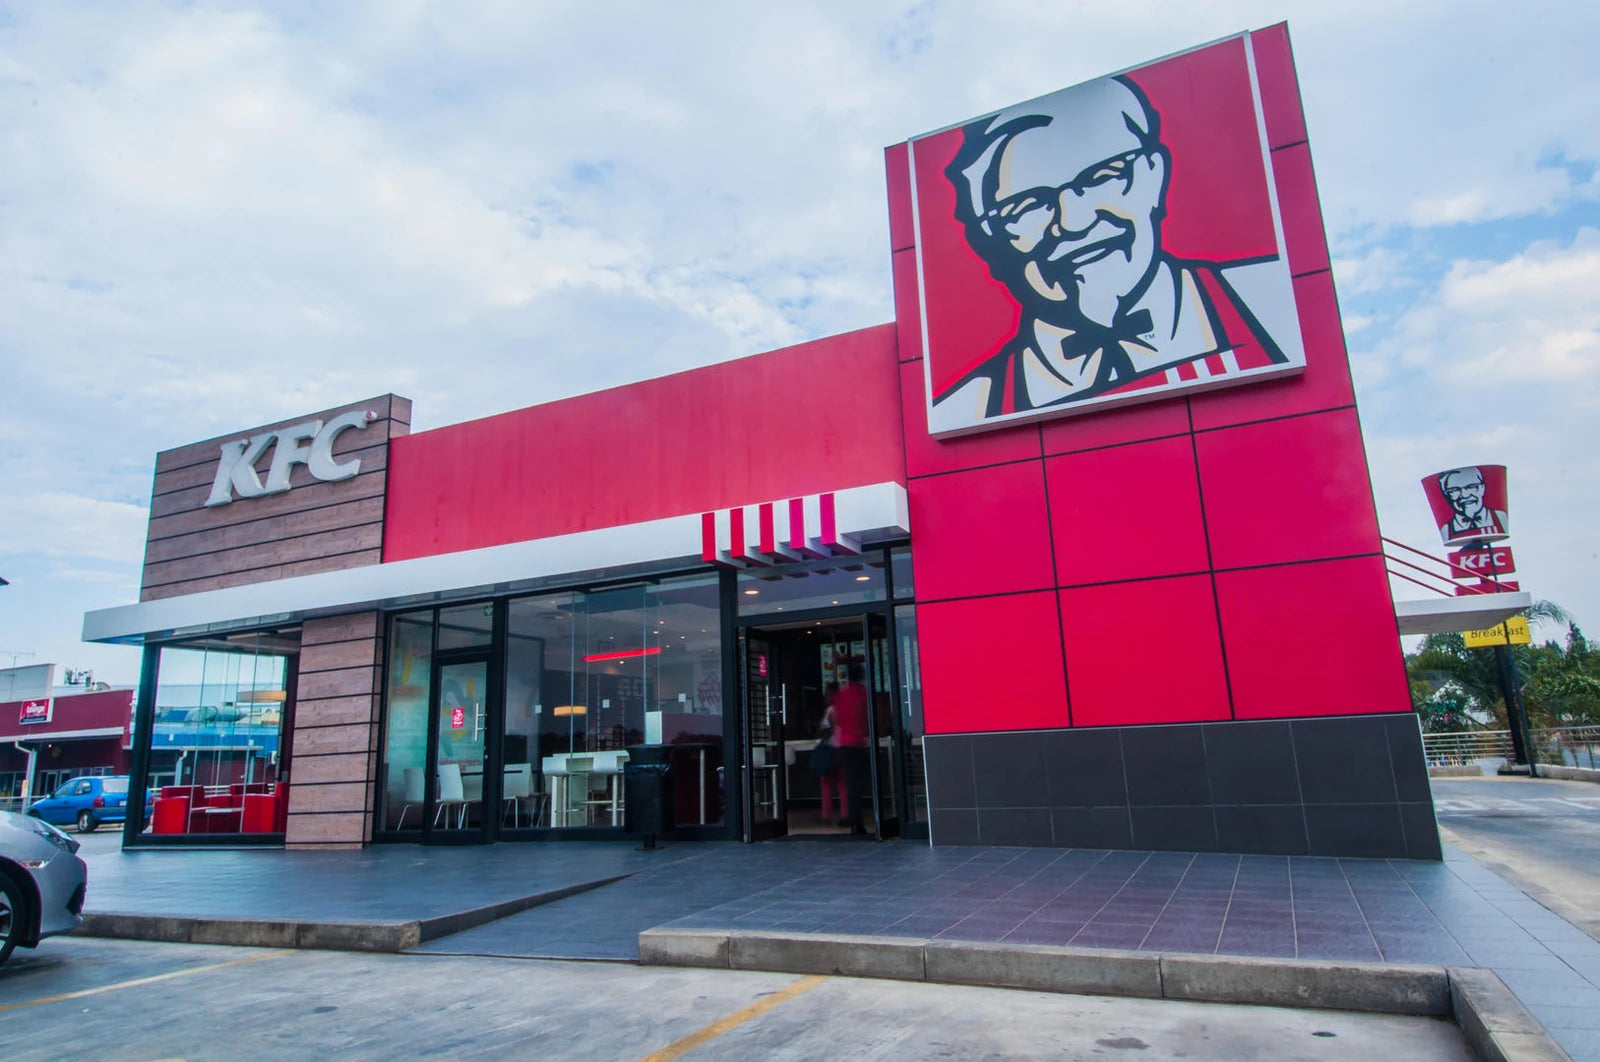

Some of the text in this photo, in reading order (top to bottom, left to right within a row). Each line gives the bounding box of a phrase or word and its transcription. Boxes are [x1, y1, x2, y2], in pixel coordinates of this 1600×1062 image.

[203, 410, 370, 508] KFC
[1459, 553, 1506, 569] KFC
[1470, 625, 1525, 639] Breakast
